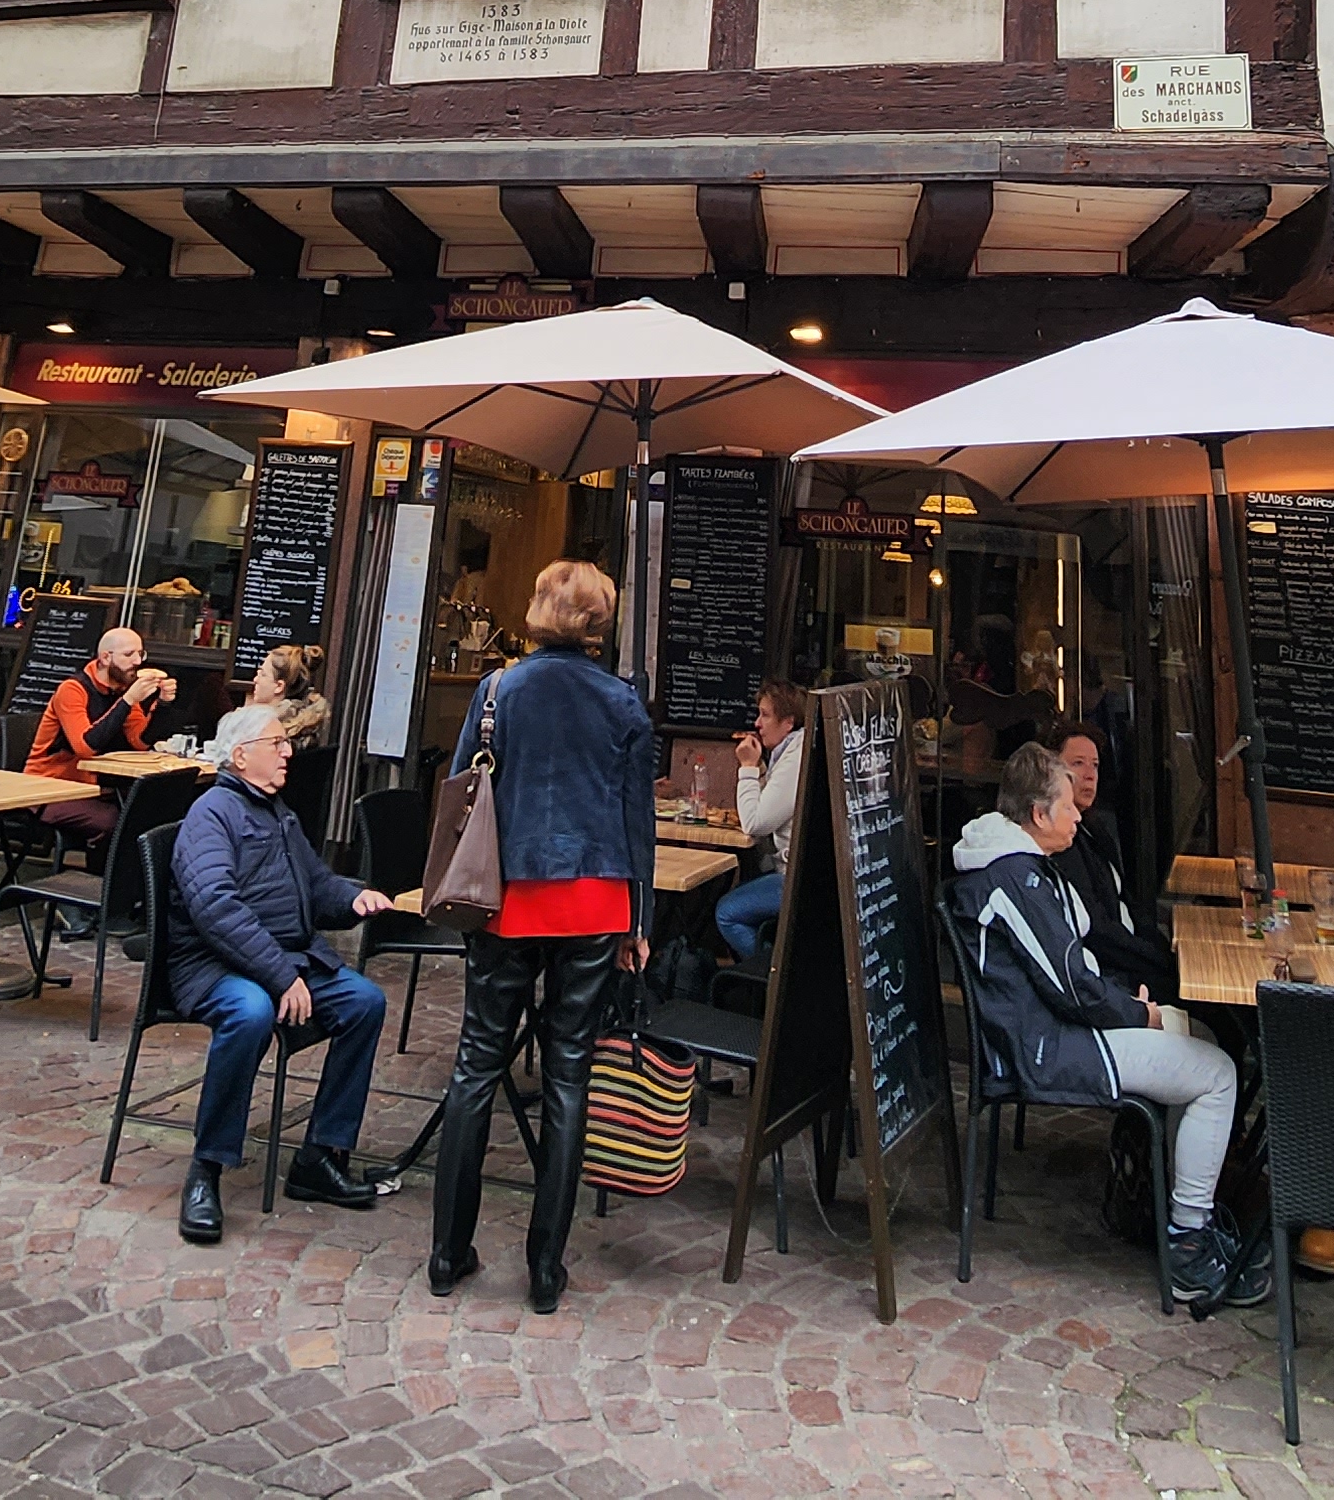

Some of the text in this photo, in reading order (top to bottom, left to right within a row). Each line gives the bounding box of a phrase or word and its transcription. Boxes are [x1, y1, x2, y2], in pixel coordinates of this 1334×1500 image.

[481, 3, 521, 19] 1383
[435, 25, 455, 36] zur
[458, 20, 485, 35] Gige
[492, 18, 534, 32] Maison
[544, 18, 556, 31] la
[408, 31, 592, 53] appartenant à la famille Schongauer
[440, 47, 550, 63] de 1465 à 1583
[1170, 65, 1211, 77] RUE
[1122, 80, 1242, 98] des MARCHANDS
[505, 281, 520, 296] LE
[37, 358, 144, 384] Restaurant
[158, 361, 258, 387] Saladerie
[679, 467, 755, 480] TARTES FLAMBÉES
[1247, 491, 1293, 506] SALADES
[847, 501, 860, 515] LE
[798, 514, 909, 536] SCHONGAUER
[816, 541, 888, 552] RESTAURANT
[1279, 644, 1334, 666] PIZZAS
